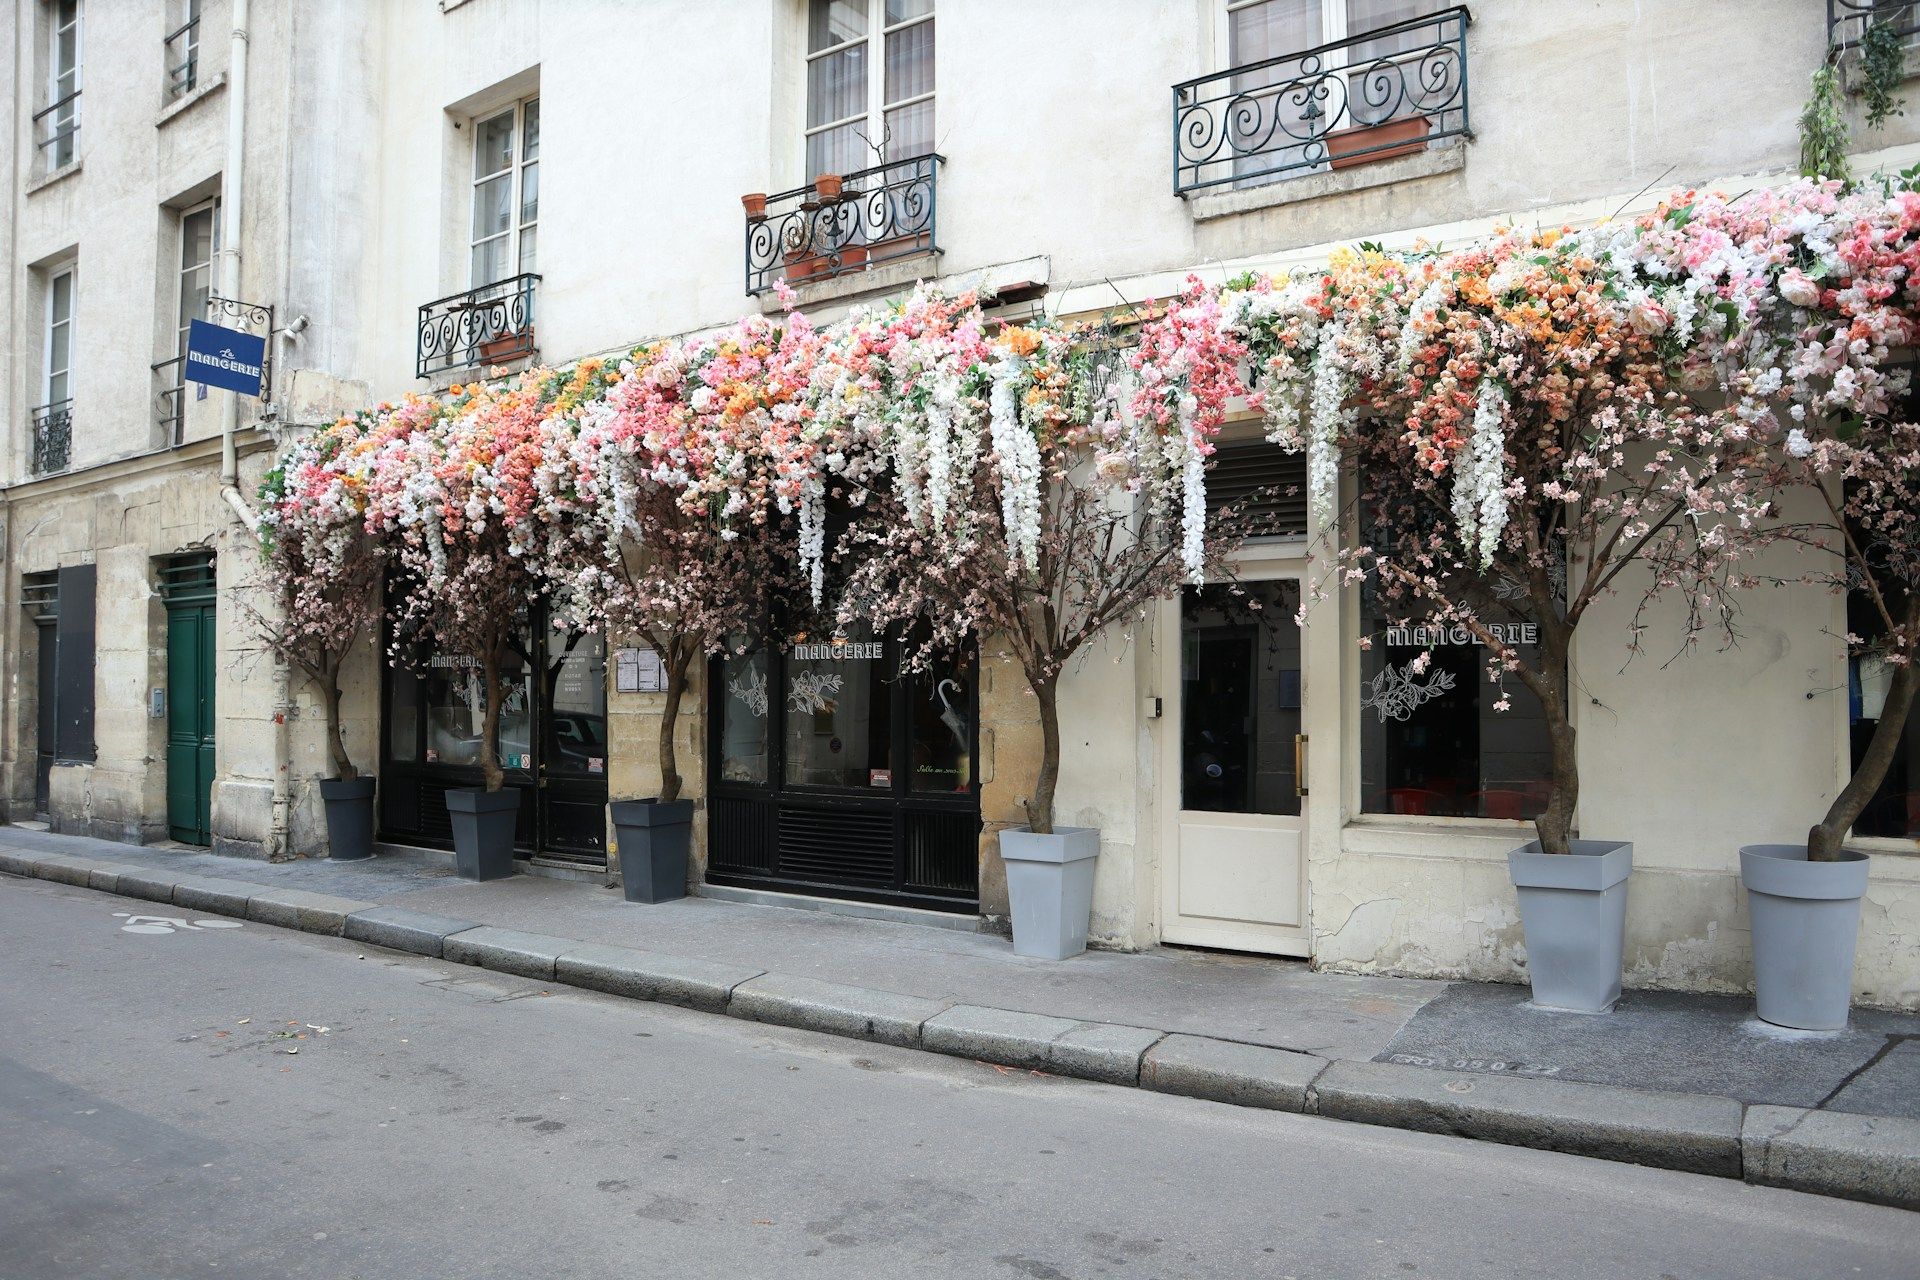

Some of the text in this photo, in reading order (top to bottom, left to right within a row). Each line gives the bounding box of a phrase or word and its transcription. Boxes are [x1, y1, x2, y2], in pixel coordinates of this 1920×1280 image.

[219, 348, 236, 360] La
[189, 350, 260, 378] MANGERIE
[794, 642, 883, 660] MANGERIE
[431, 655, 483, 668] MANERI
